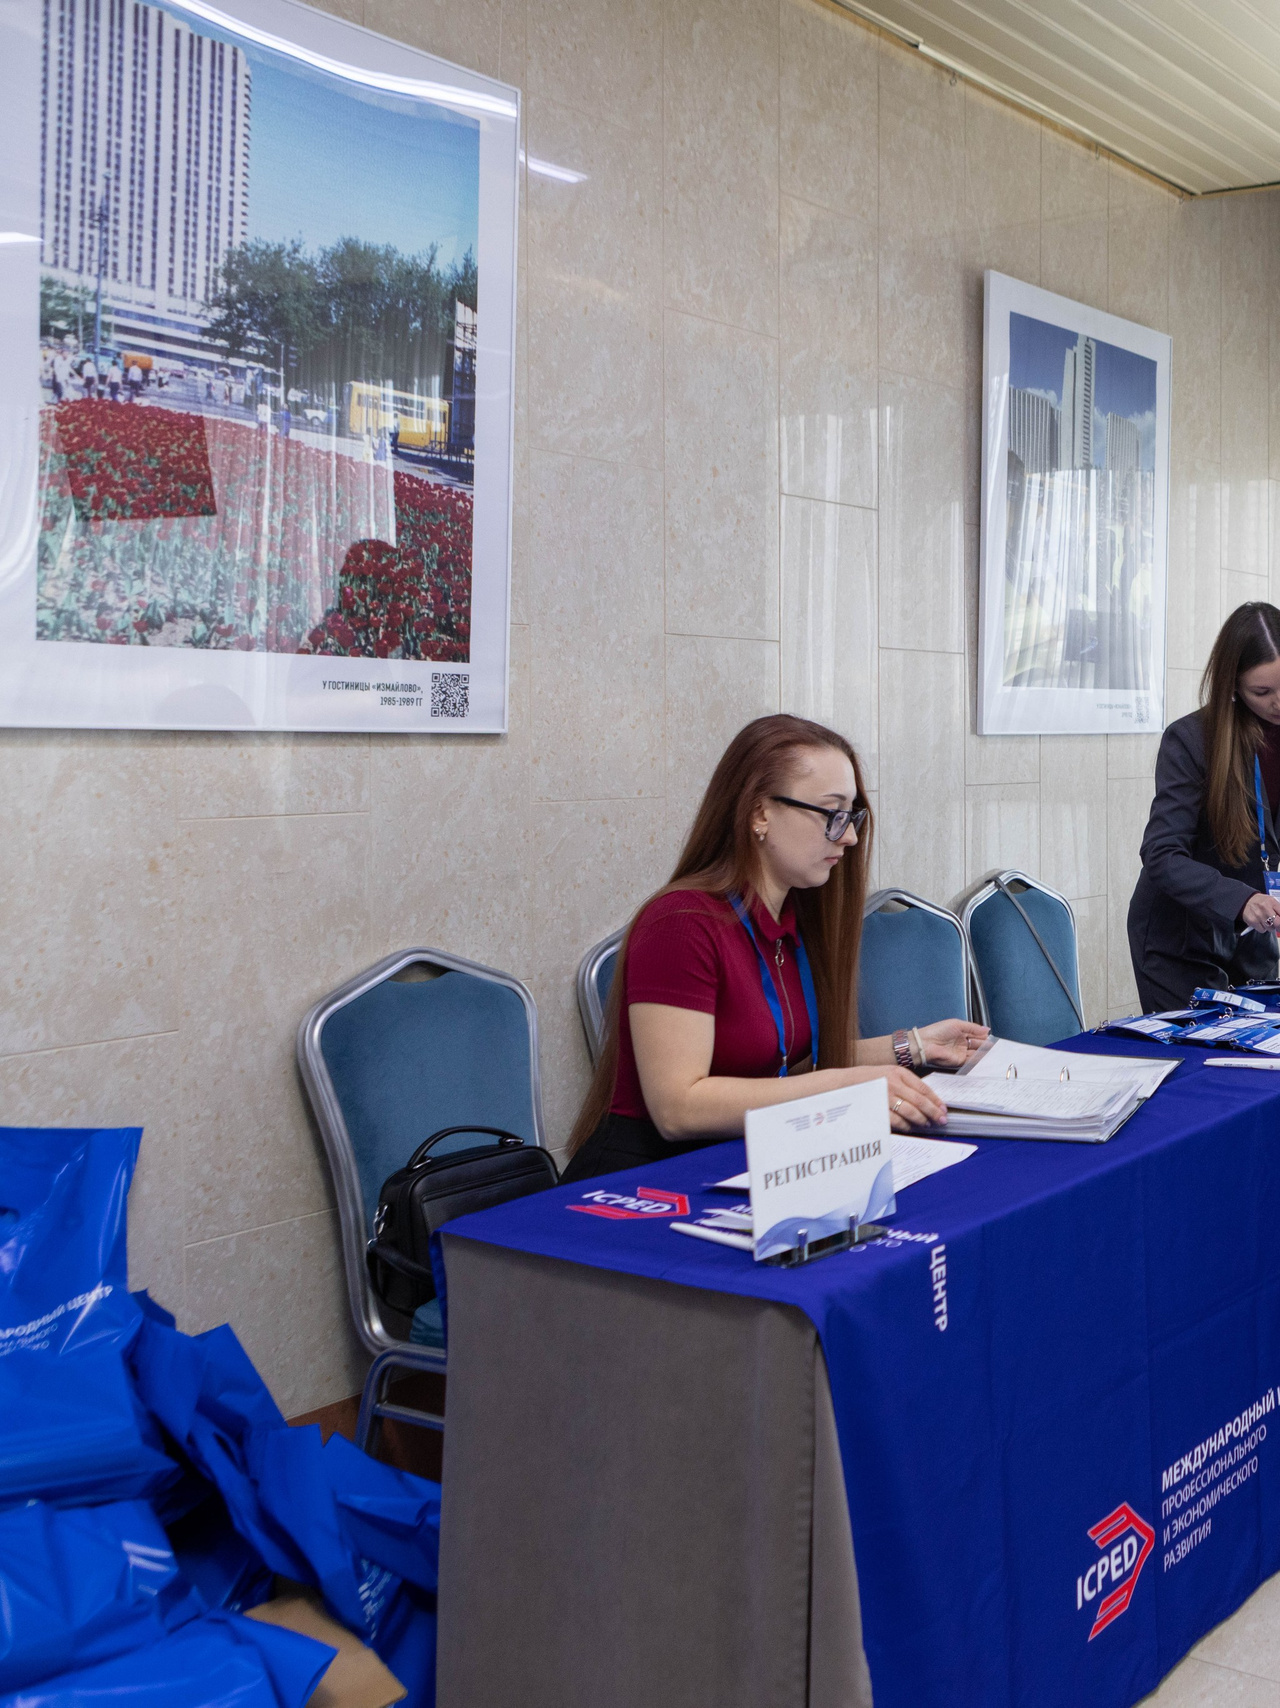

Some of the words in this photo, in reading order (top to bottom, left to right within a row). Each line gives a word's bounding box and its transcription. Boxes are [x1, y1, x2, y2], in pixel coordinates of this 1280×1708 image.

[322, 681, 327, 690] У
[328, 681, 370, 691] ГОСТИНИЦЫ
[380, 697, 414, 706] 1985-1989
[763, 1140, 881, 1190] РЕГИСТРАЦИЯ
[581, 1190, 672, 1213] ICPED
[929, 1244, 948, 1332] ЦЕНТР
[1161, 1387, 1275, 1493] МЕЖДУНАРОДНЫЙ
[1161, 1424, 1267, 1519] ПРОФЕССИОНАЛЬНОГО
[1163, 1527, 1171, 1546] И
[1172, 1456, 1258, 1538] ЭКОНОМИЧЕСКОГО
[1077, 1535, 1138, 1610] ICPED
[1164, 1518, 1212, 1573] РАЗВИТИЯ
